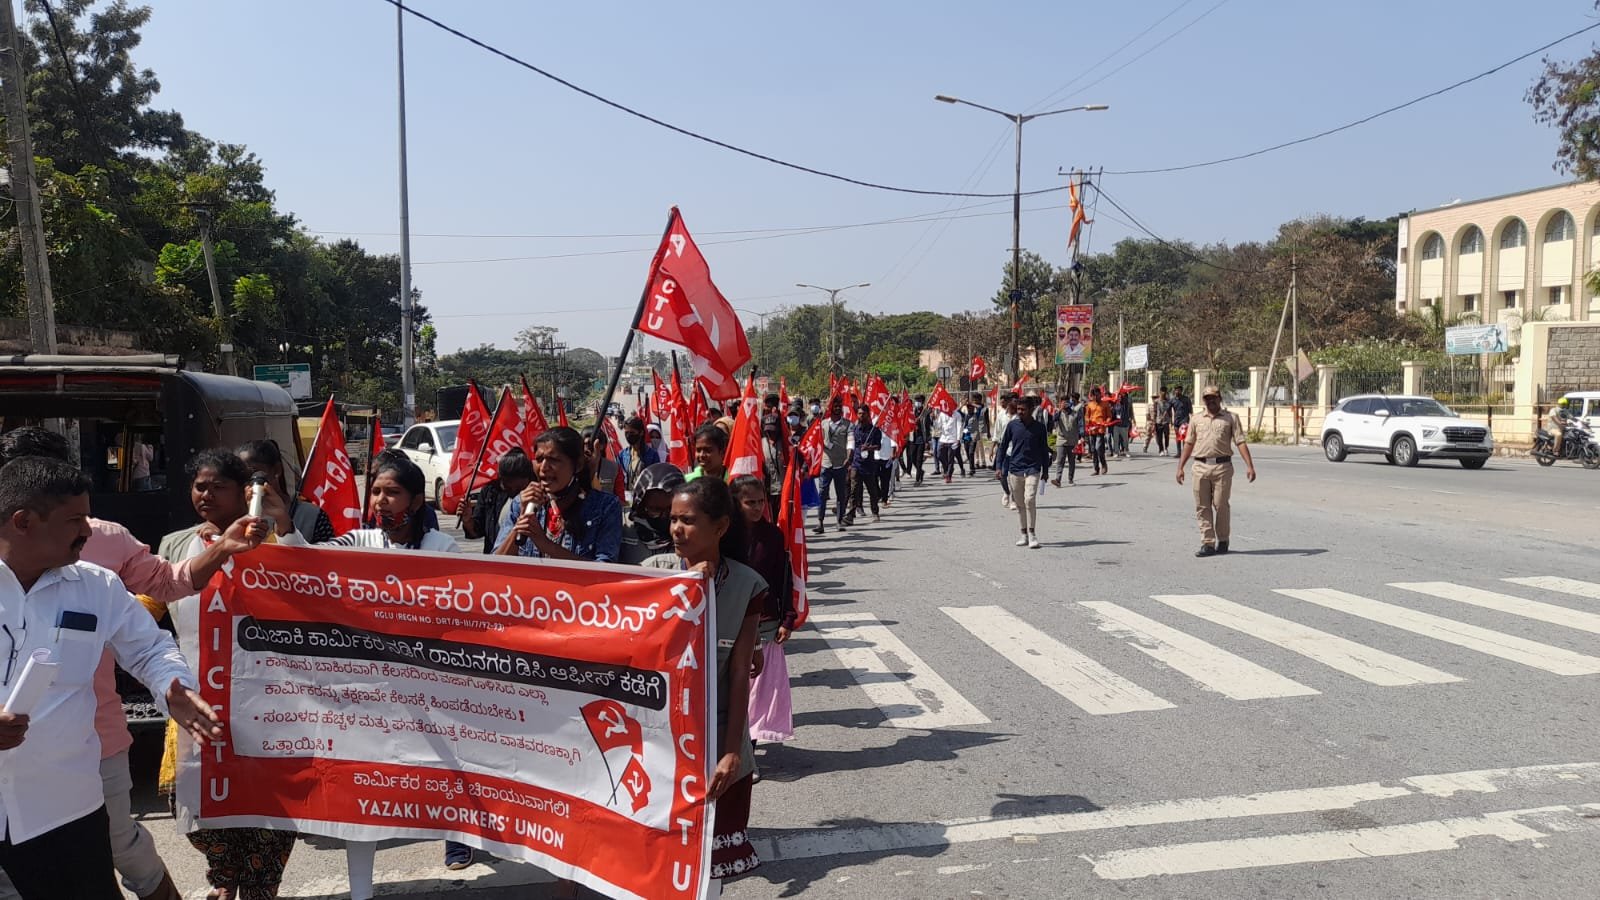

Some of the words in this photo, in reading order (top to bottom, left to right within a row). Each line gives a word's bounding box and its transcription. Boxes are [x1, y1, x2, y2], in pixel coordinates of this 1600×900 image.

[241, 562, 342, 598] ಯಾಜಾಕಿ
[347, 574, 474, 613] ಕಾರ್ಮಿಕರ
[480, 585, 659, 632] ಯೂನಿಯನ್
[374, 610, 394, 620] KGLU
[419, 616, 434, 624] NO.
[308, 628, 385, 651] ಕಾರ್ಮಿಕರ
[428, 648, 511, 674] ರಾಮನಗರ
[515, 656, 547, 680] ಡಿಸಿ
[549, 665, 616, 687] ಆಫೀಸ್
[619, 671, 661, 700] ಕಡೆಗೆ
[353, 771, 421, 790] ಕಾರ್ಮಿಕರ
[425, 778, 464, 800] ಐಕ್ಯತೆ
[468, 782, 570, 818] ಚಿರಾಯುವಾಗಲಿ!
[671, 641, 699, 892] AICCTU
[357, 798, 420, 818] YAZAKI
[425, 804, 510, 832] WORKERS'
[514, 817, 564, 850] UNION
